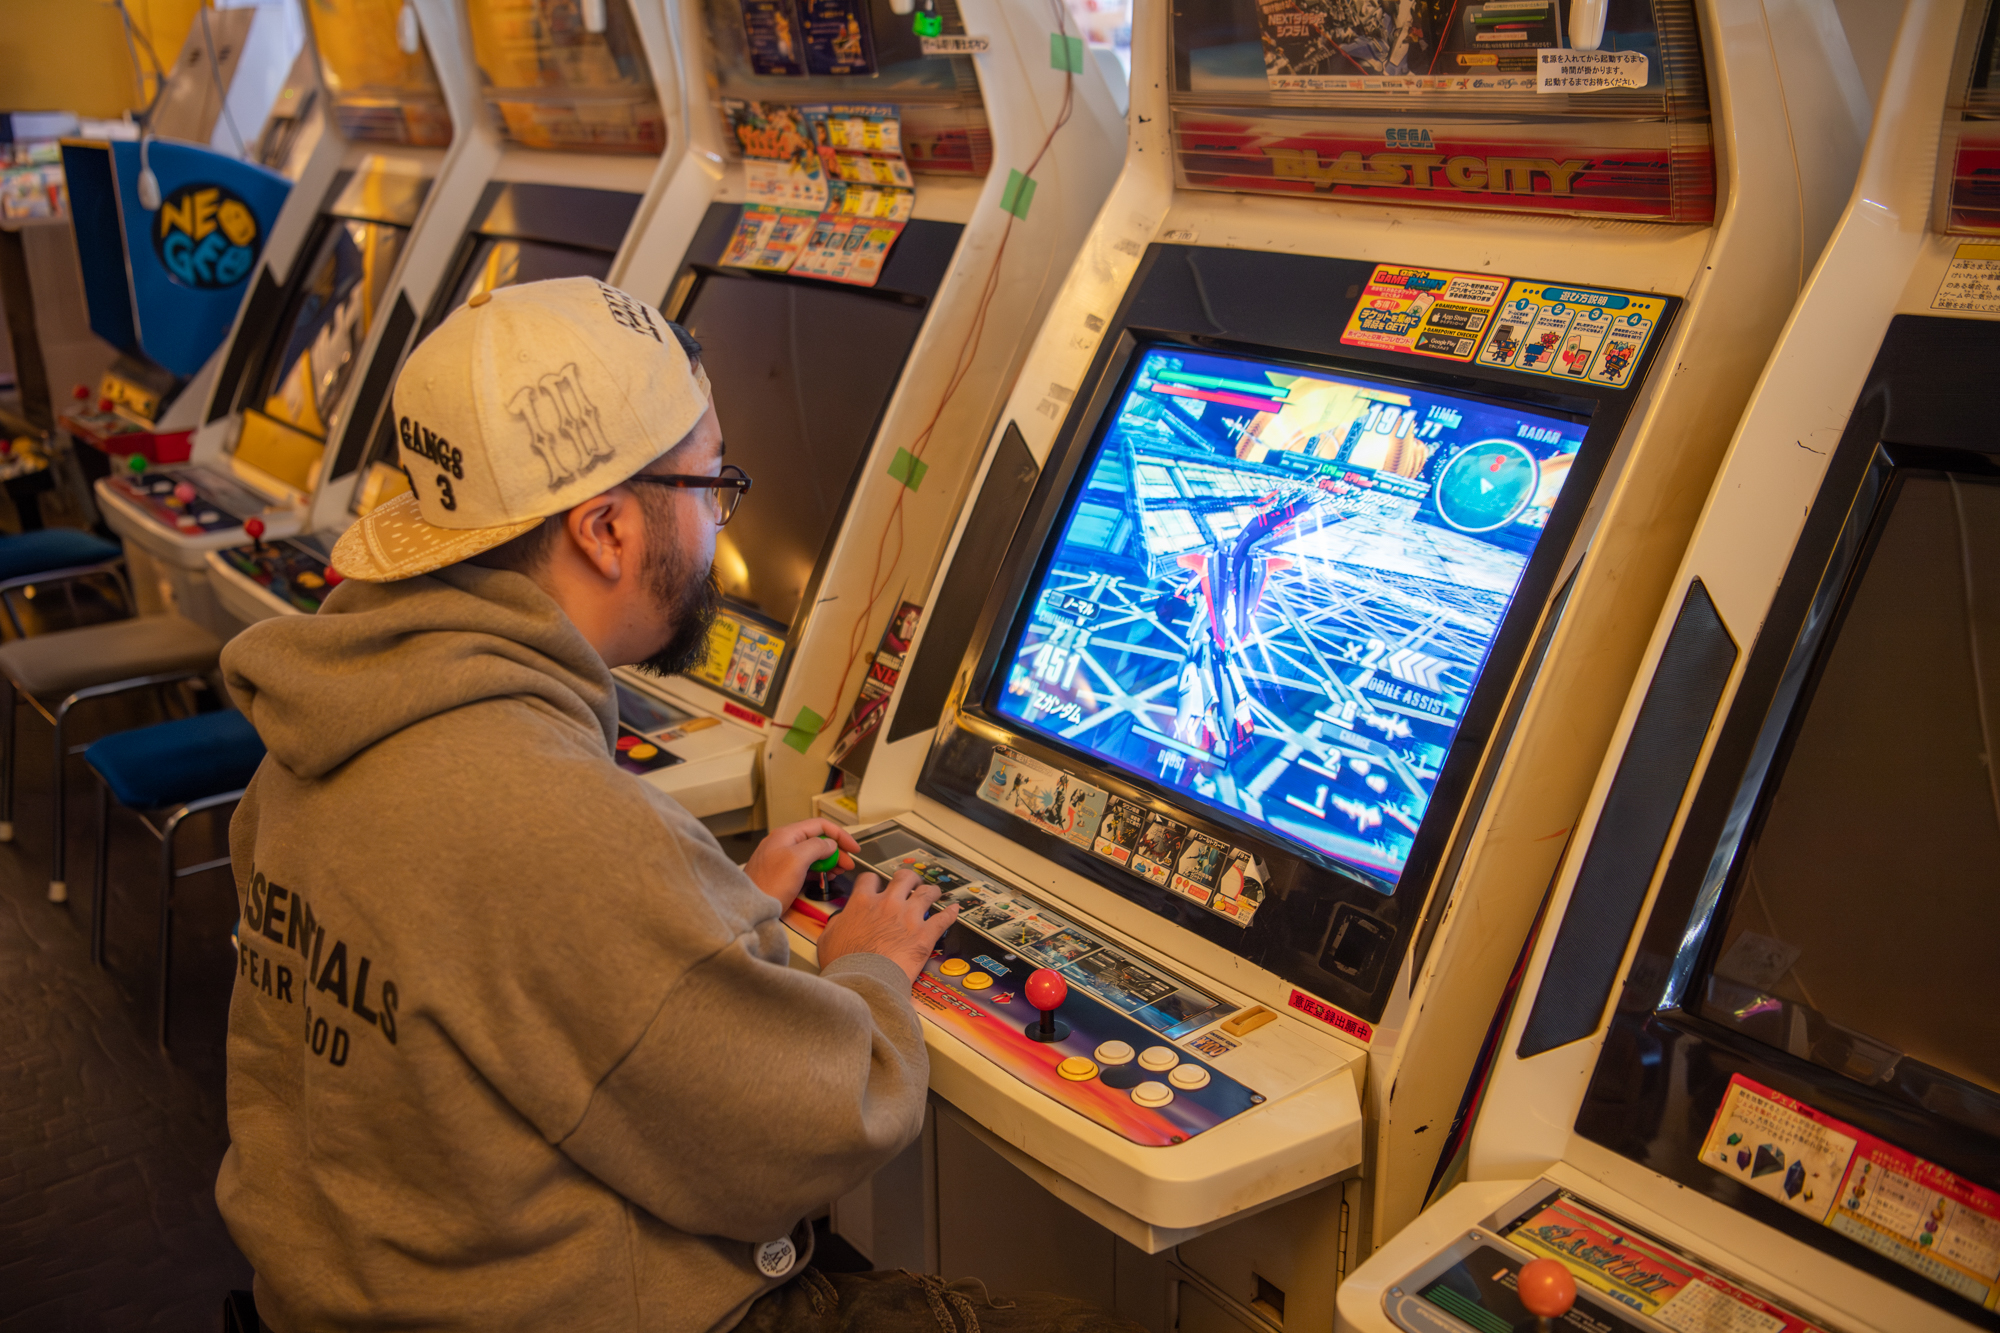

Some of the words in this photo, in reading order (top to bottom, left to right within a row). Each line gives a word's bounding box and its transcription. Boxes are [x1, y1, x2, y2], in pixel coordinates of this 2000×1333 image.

[1541, 54, 1645, 64] 電源を入れてから起動するまで
[1560, 66, 1624, 76] 時間が掛かります。
[1544, 78, 1637, 88] 起動するまでお待ちください。
[1385, 128, 1433, 149] SEGA
[1262, 147, 1447, 188] BLAST
[1446, 155, 1589, 194] CITY
[160, 187, 257, 247] NEO
[163, 230, 253, 284] GEO
[1519, 301, 1526, 309] 1
[1554, 305, 1562, 313] 2
[1559, 290, 1608, 306] 遊び方説明
[1359, 309, 1420, 326] チケットを集めて
[1454, 314, 1468, 322] Store
[1591, 309, 1600, 319] 3
[1629, 314, 1638, 324] 4
[1430, 337, 1446, 347] Google
[1446, 339, 1457, 347] Play
[1427, 404, 1458, 422] TIME
[1516, 423, 1563, 445] RADAR
[1063, 597, 1095, 616] ノーマル
[1032, 642, 1081, 692] 451
[1033, 690, 1081, 726] Zガンダム
[1341, 699, 1359, 721] 6
[1402, 687, 1450, 718] ASSIST
[1156, 748, 1187, 771] BOOST
[1323, 747, 1343, 769] 2
[1314, 783, 1330, 810] 1
[243, 862, 400, 1045] SENIALS
[240, 942, 293, 1004] FEAR
[971, 954, 1010, 978] SEGA
[1294, 993, 1369, 1039] 意匠登録出願中
[1193, 1036, 1227, 1058] ¥100
[1771, 1090, 1798, 1111] ジェム
